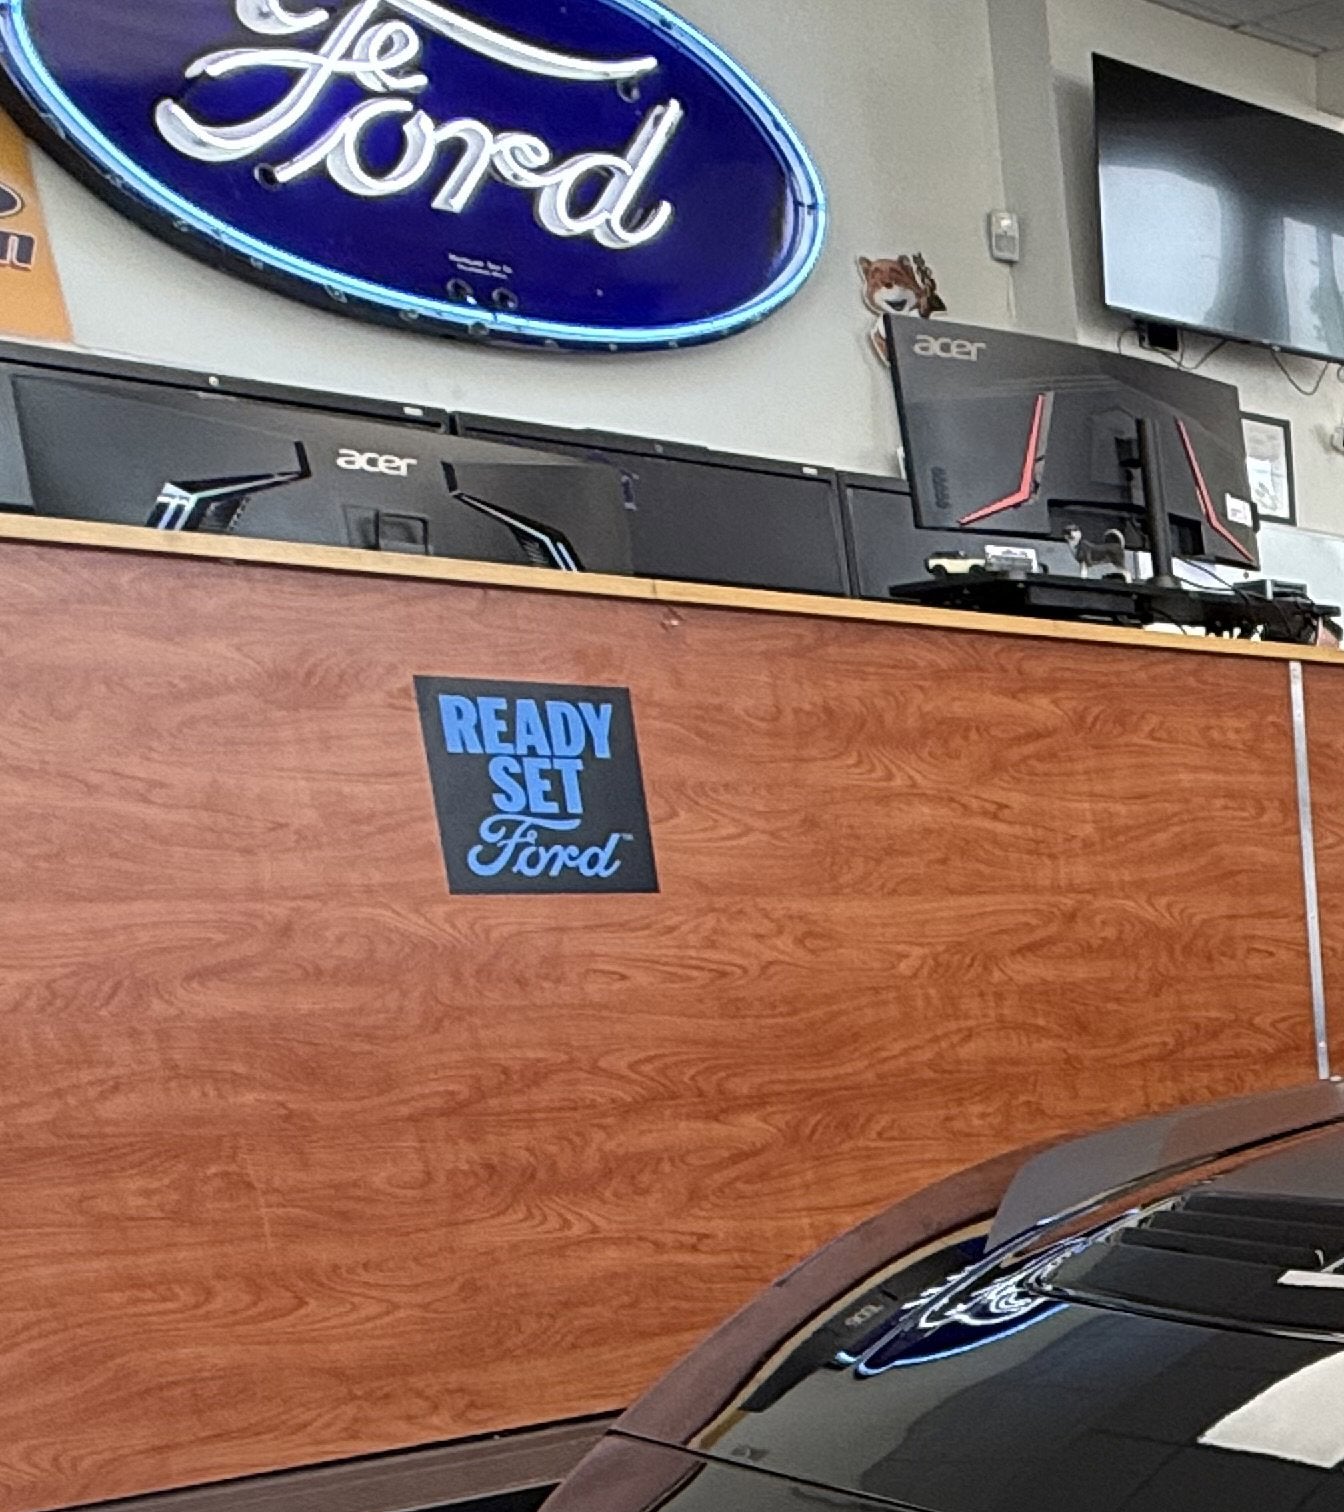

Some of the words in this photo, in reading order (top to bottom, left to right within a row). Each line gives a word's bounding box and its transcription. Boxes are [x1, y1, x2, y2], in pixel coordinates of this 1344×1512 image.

[155, 0, 684, 249] Ford
[913, 334, 986, 361] acer
[336, 448, 418, 477] acer
[438, 694, 613, 760] READY
[488, 756, 584, 814] SET
[467, 814, 622, 878] Ford
